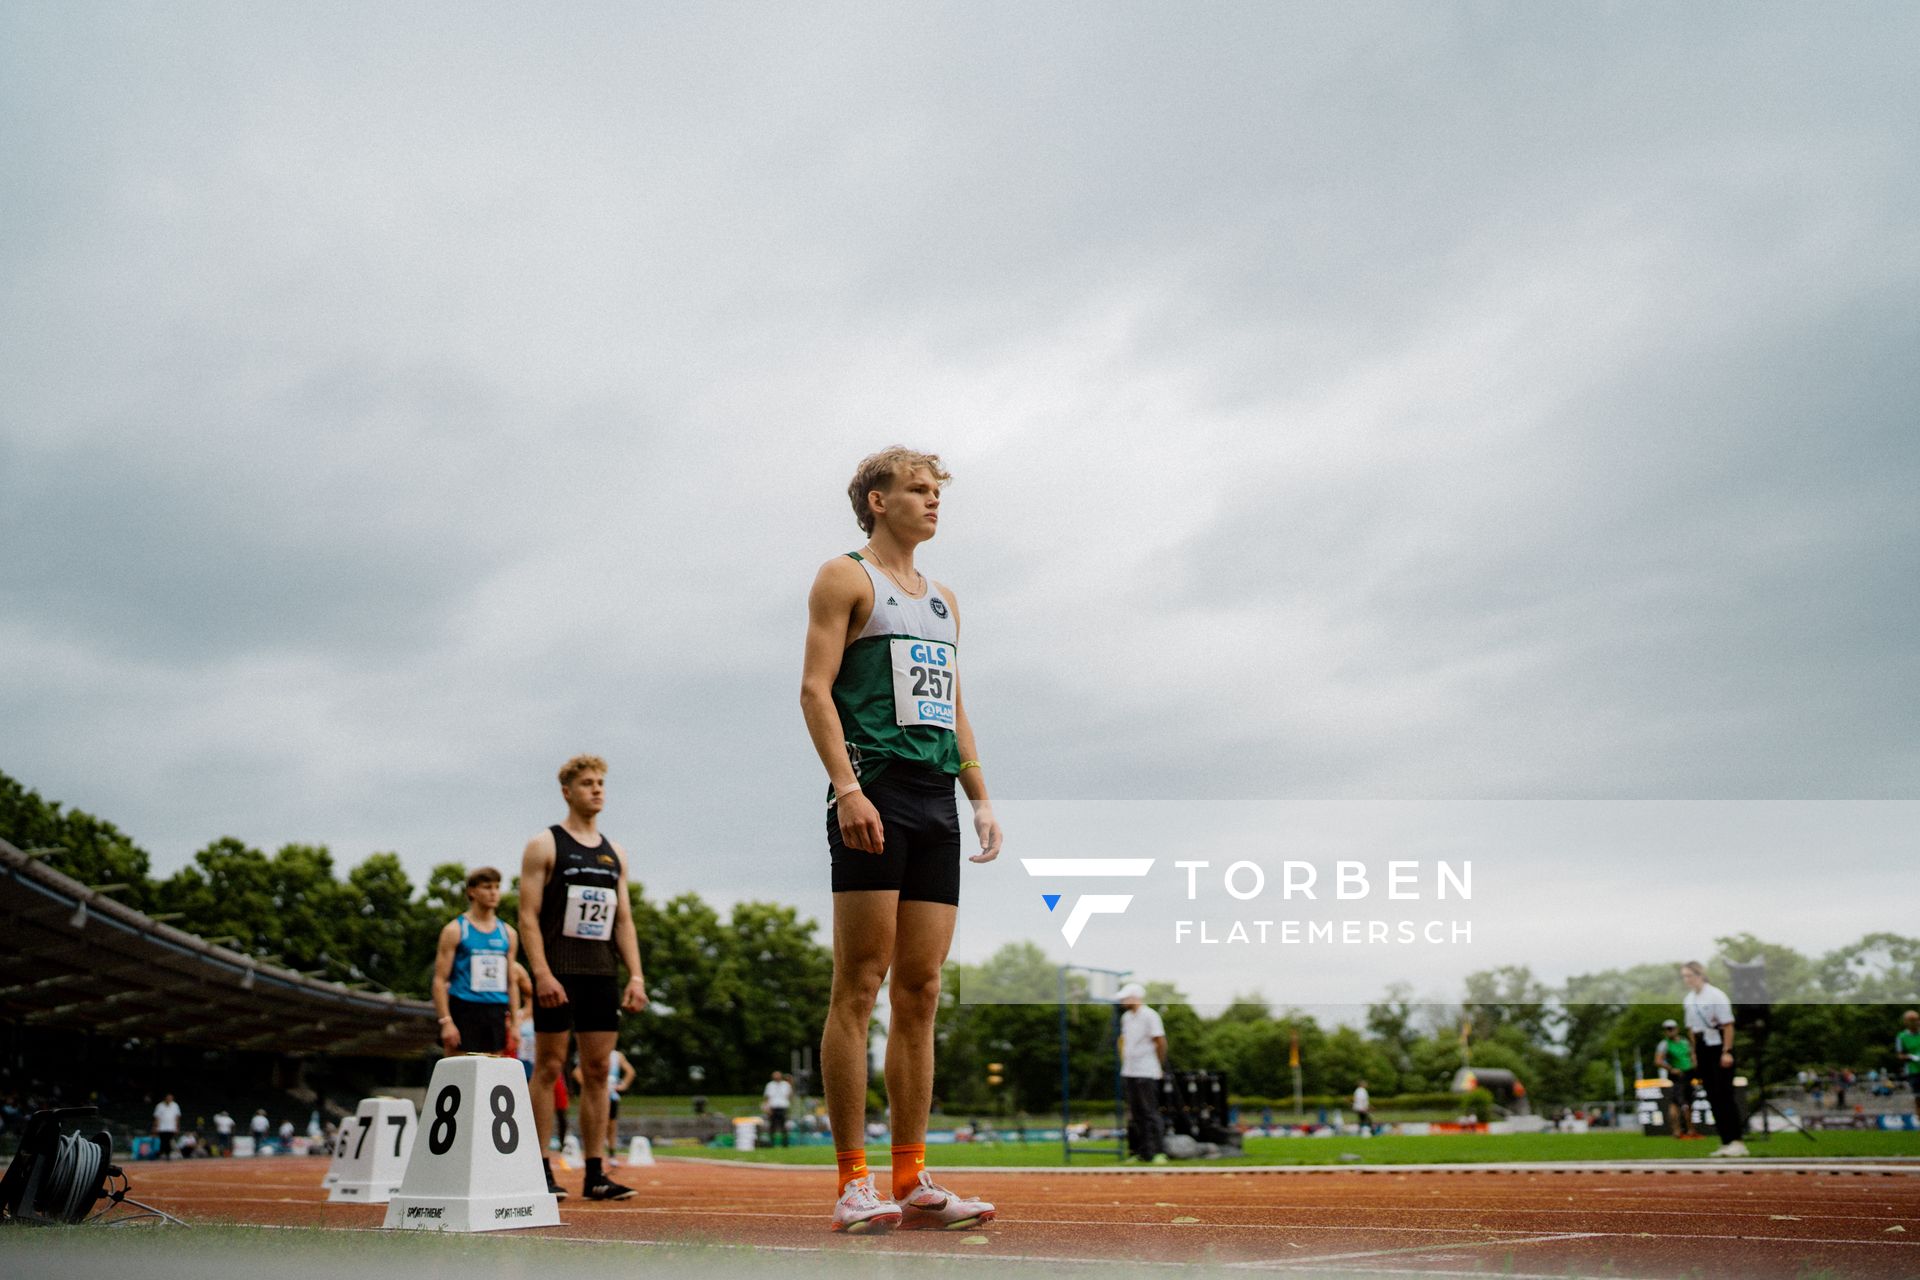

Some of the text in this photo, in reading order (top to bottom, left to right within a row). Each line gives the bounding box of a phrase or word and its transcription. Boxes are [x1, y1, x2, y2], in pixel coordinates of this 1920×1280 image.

[910, 643, 947, 667] GLS
[909, 665, 953, 701] 257
[354, 1116, 373, 1160] 7
[387, 1115, 408, 1158] 7
[428, 1084, 462, 1156] 8
[489, 1084, 520, 1155] 8
